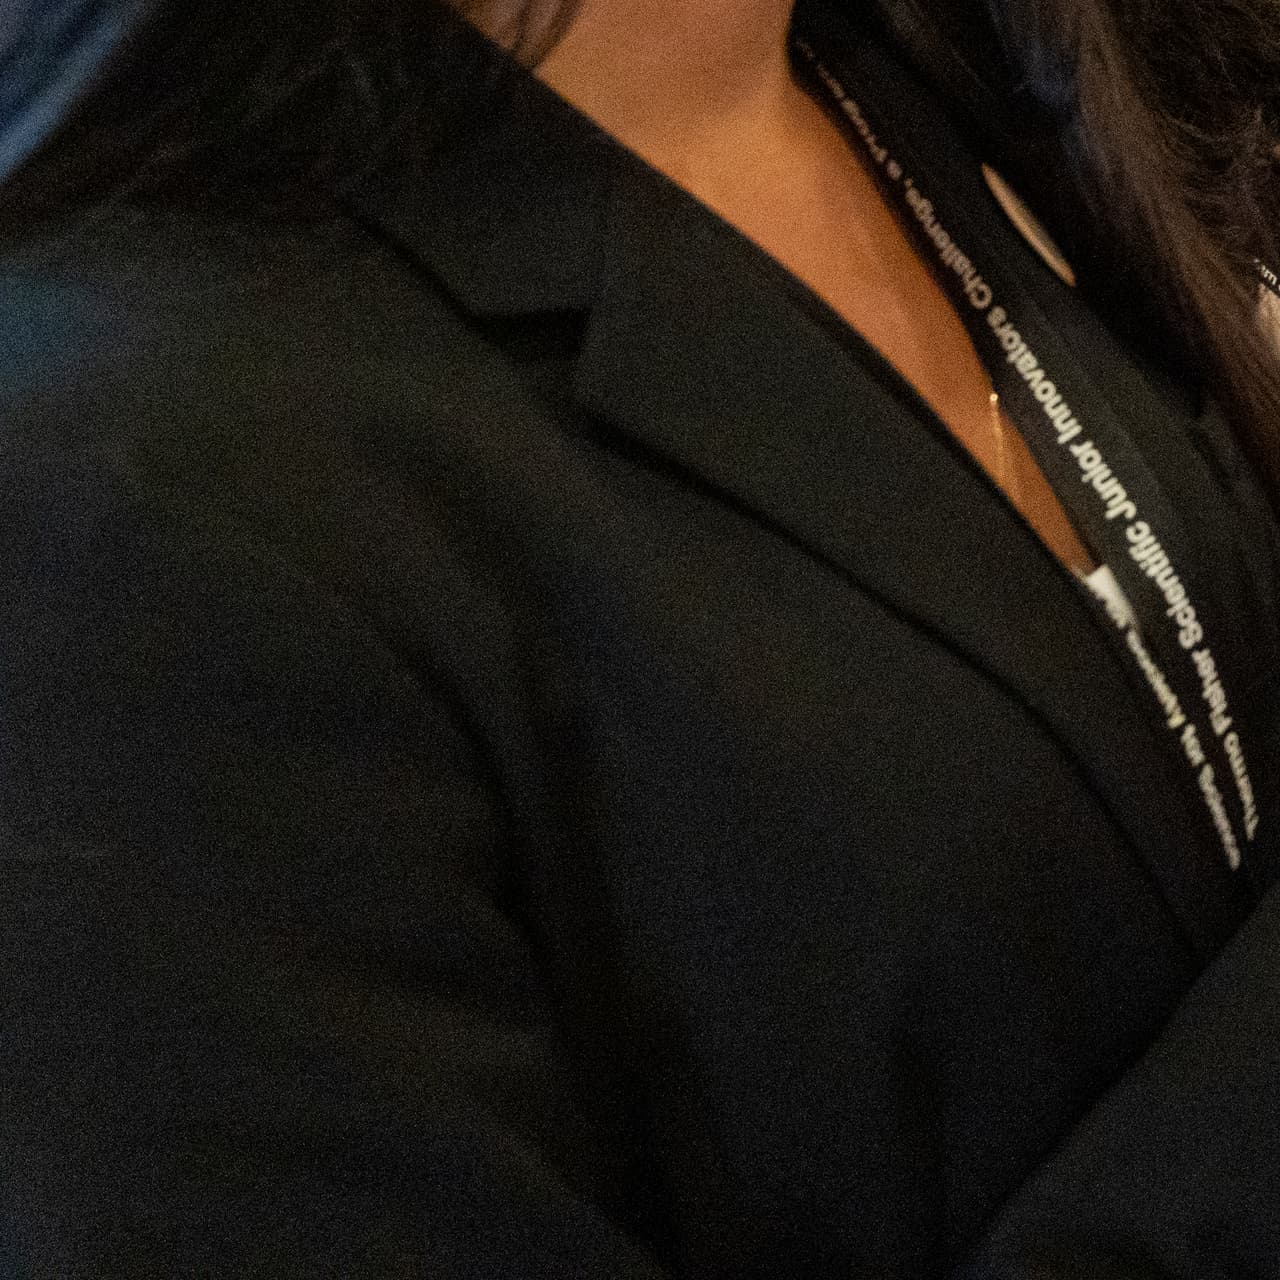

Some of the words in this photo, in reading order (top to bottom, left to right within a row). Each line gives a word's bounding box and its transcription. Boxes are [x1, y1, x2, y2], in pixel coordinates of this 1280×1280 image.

[986, 305, 1083, 445] Innovators
[1069, 440, 1137, 520] Junior
[1126, 520, 1203, 650] Scientific
[1192, 648, 1233, 736] Fisher
